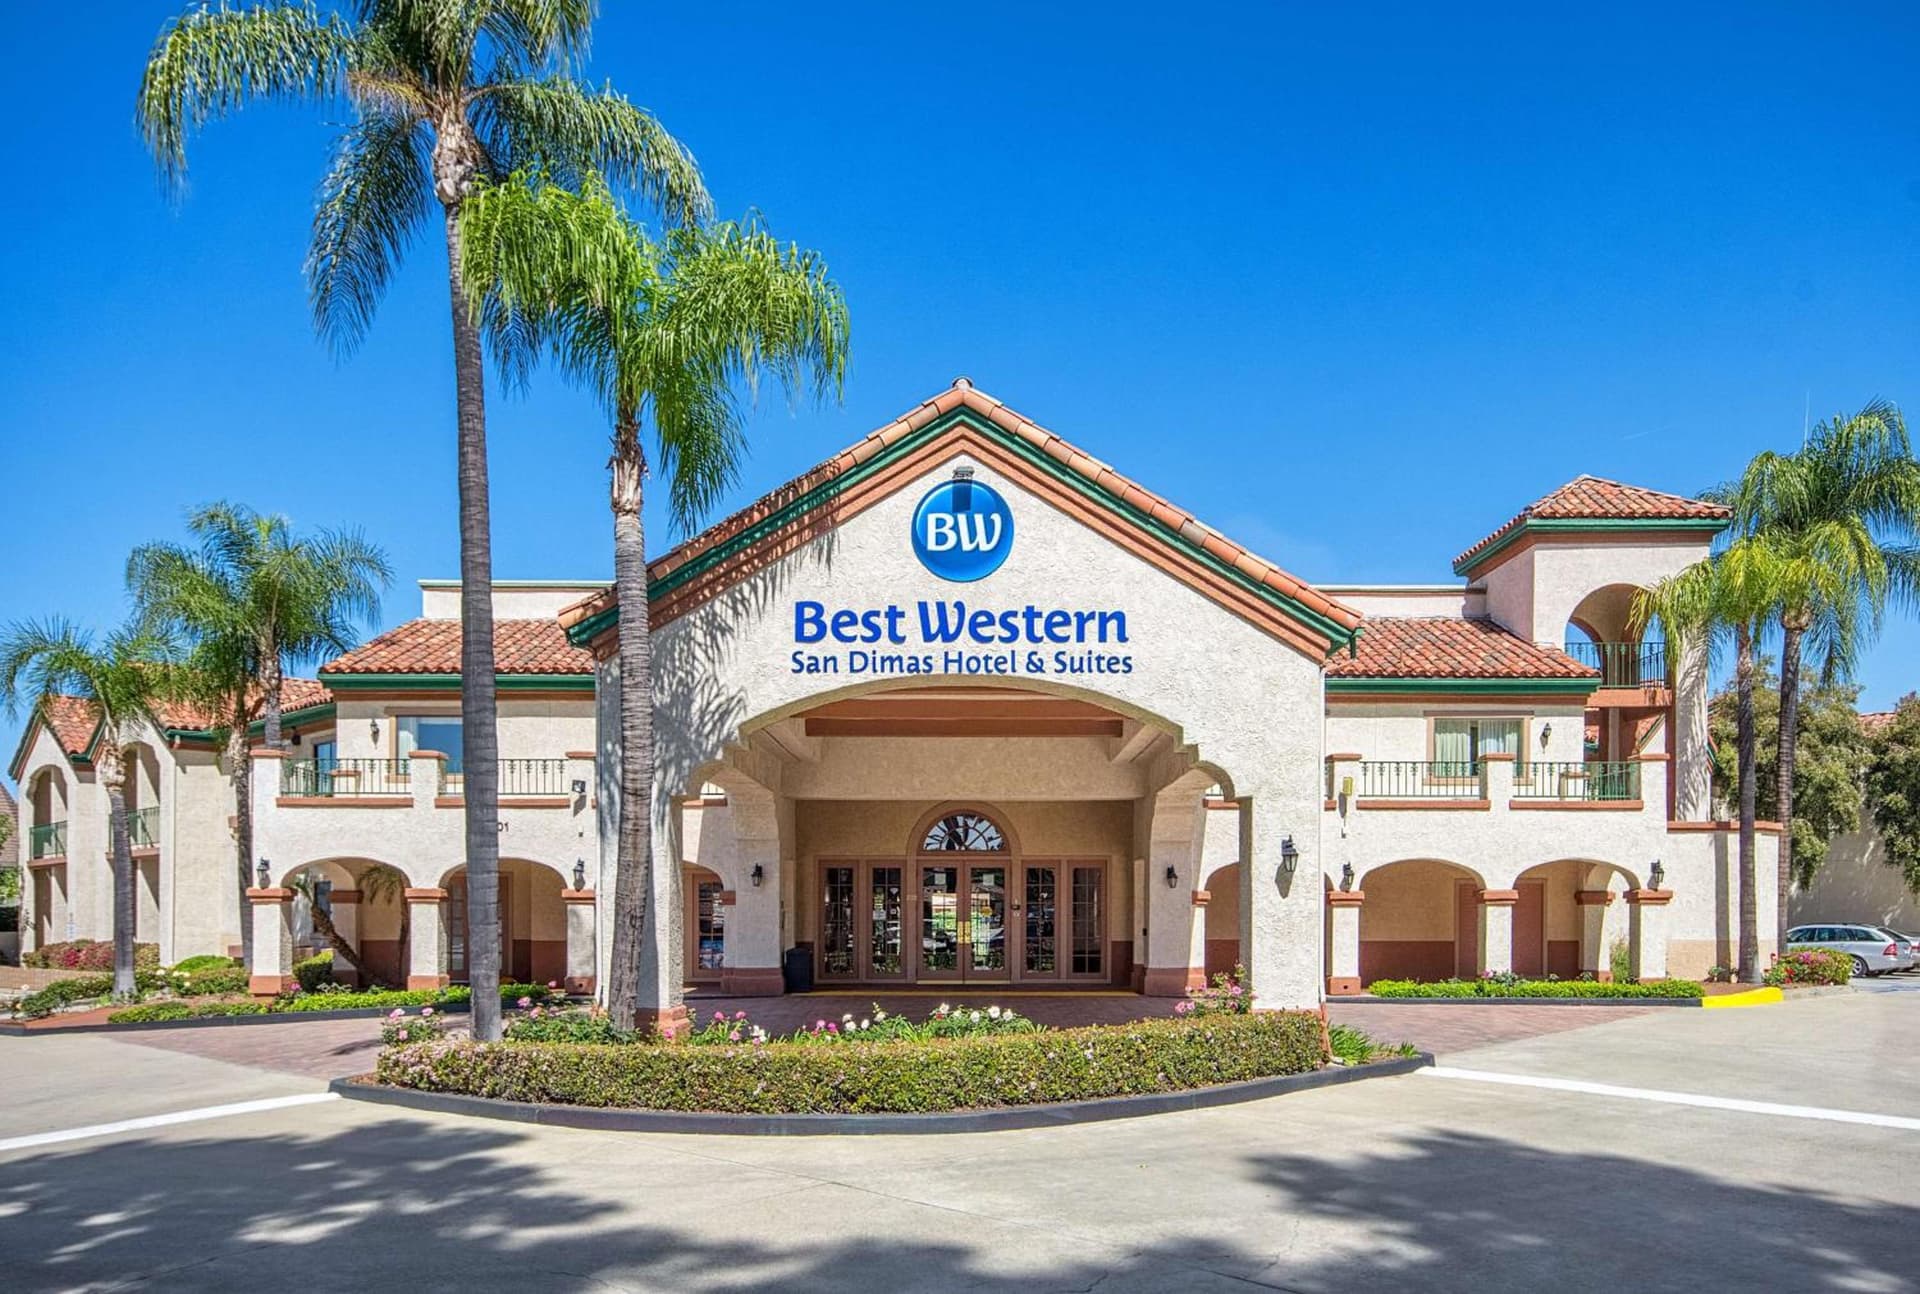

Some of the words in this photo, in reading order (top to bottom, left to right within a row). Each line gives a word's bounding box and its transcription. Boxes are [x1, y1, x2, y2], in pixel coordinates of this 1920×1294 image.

[926, 512, 1003, 552] BW
[793, 600, 907, 644] Best
[917, 600, 1129, 644] Western
[791, 650, 839, 674] San
[849, 650, 934, 674] Dimas
[943, 650, 1017, 674] Hotel
[1025, 650, 1046, 674] &
[1053, 650, 1133, 674] Suites
